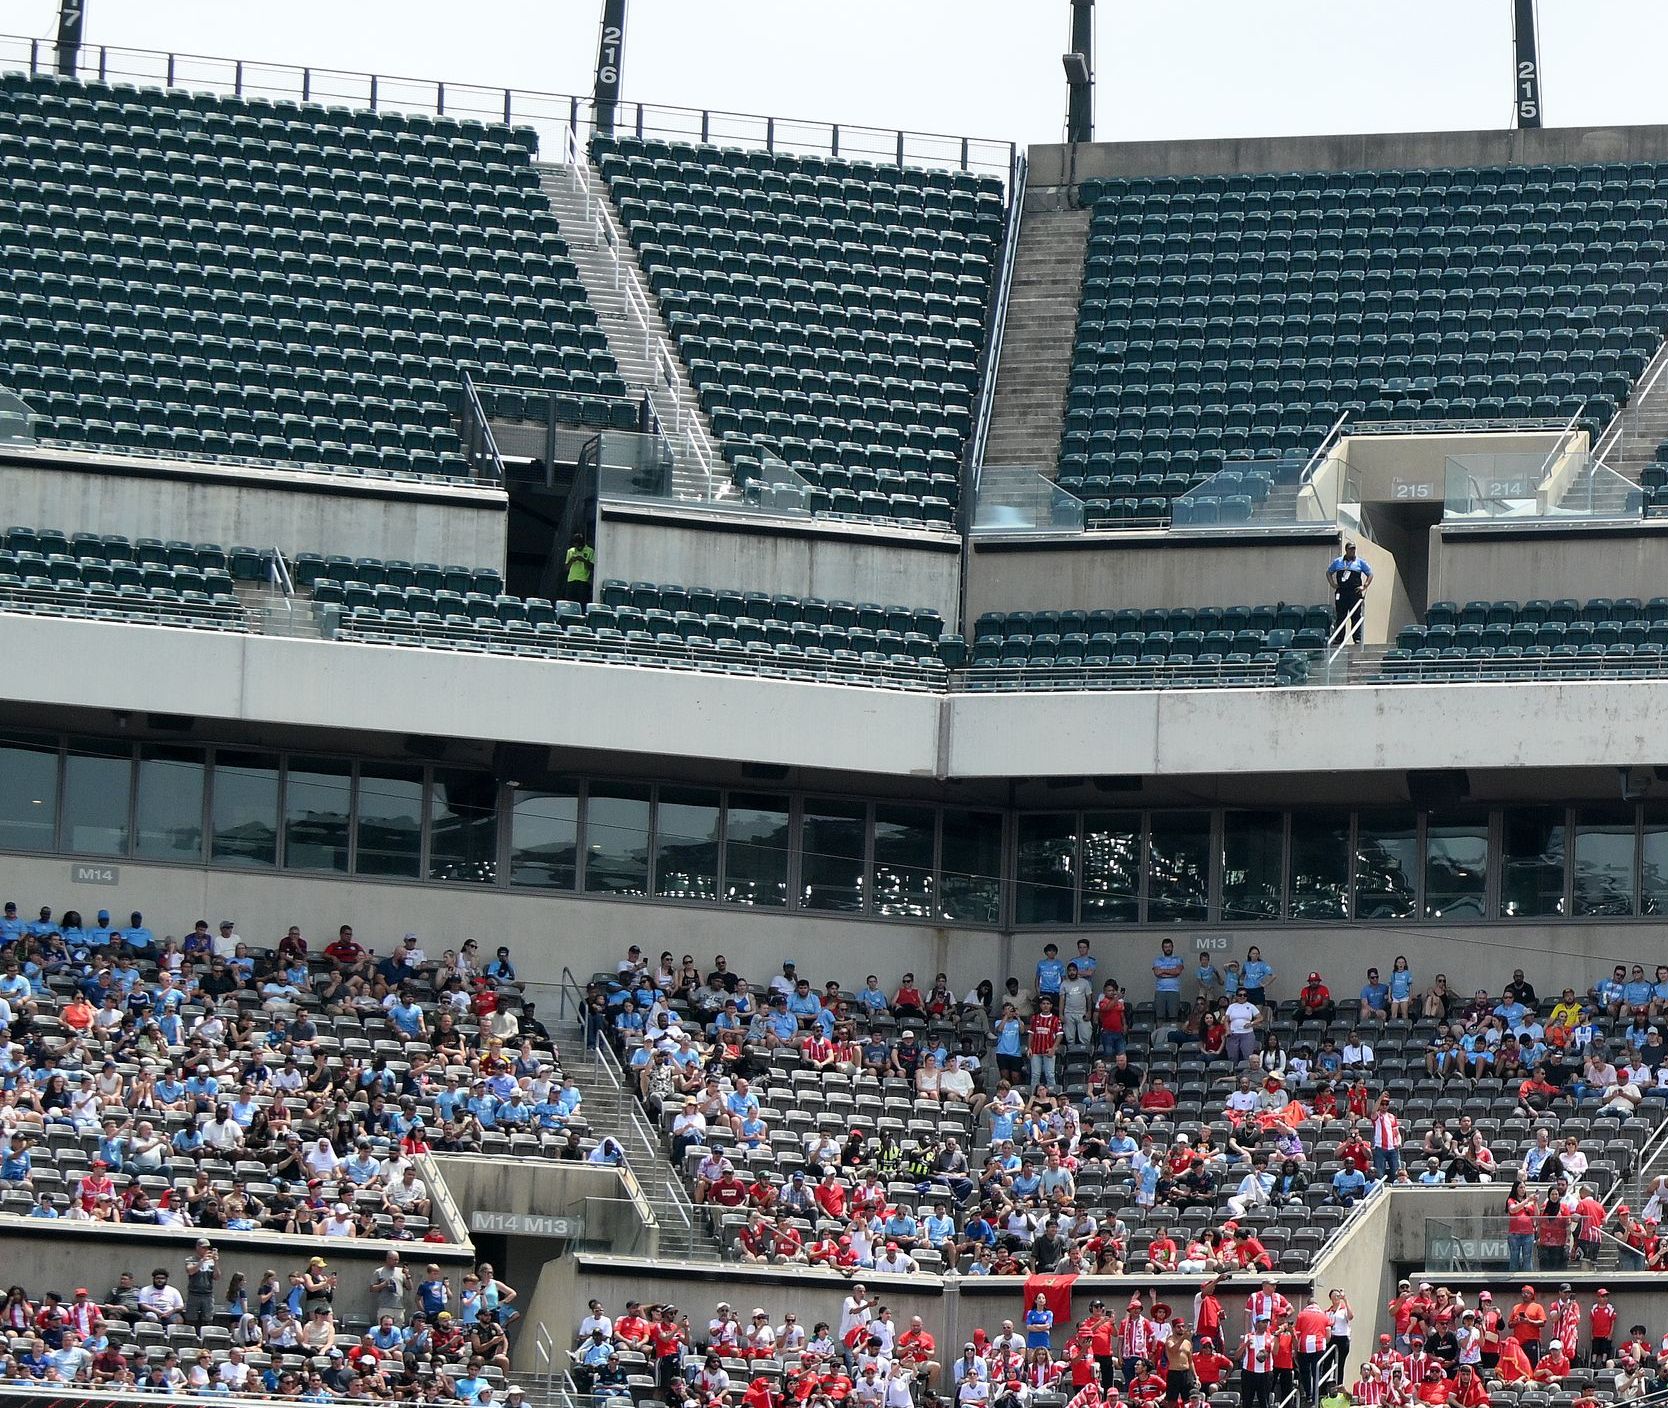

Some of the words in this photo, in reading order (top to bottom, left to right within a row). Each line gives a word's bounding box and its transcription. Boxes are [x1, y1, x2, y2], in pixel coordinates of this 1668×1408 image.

[63, 0, 82, 27] 7
[600, 26, 622, 84] 216
[1518, 61, 1537, 119] 215
[1396, 484, 1429, 498] 215
[1490, 482, 1522, 496] 214
[79, 868, 114, 881] M14
[1196, 938, 1228, 949] M13
[475, 1213, 519, 1231] M14
[524, 1216, 568, 1233] M13
[1480, 1238, 1508, 1257] M1
